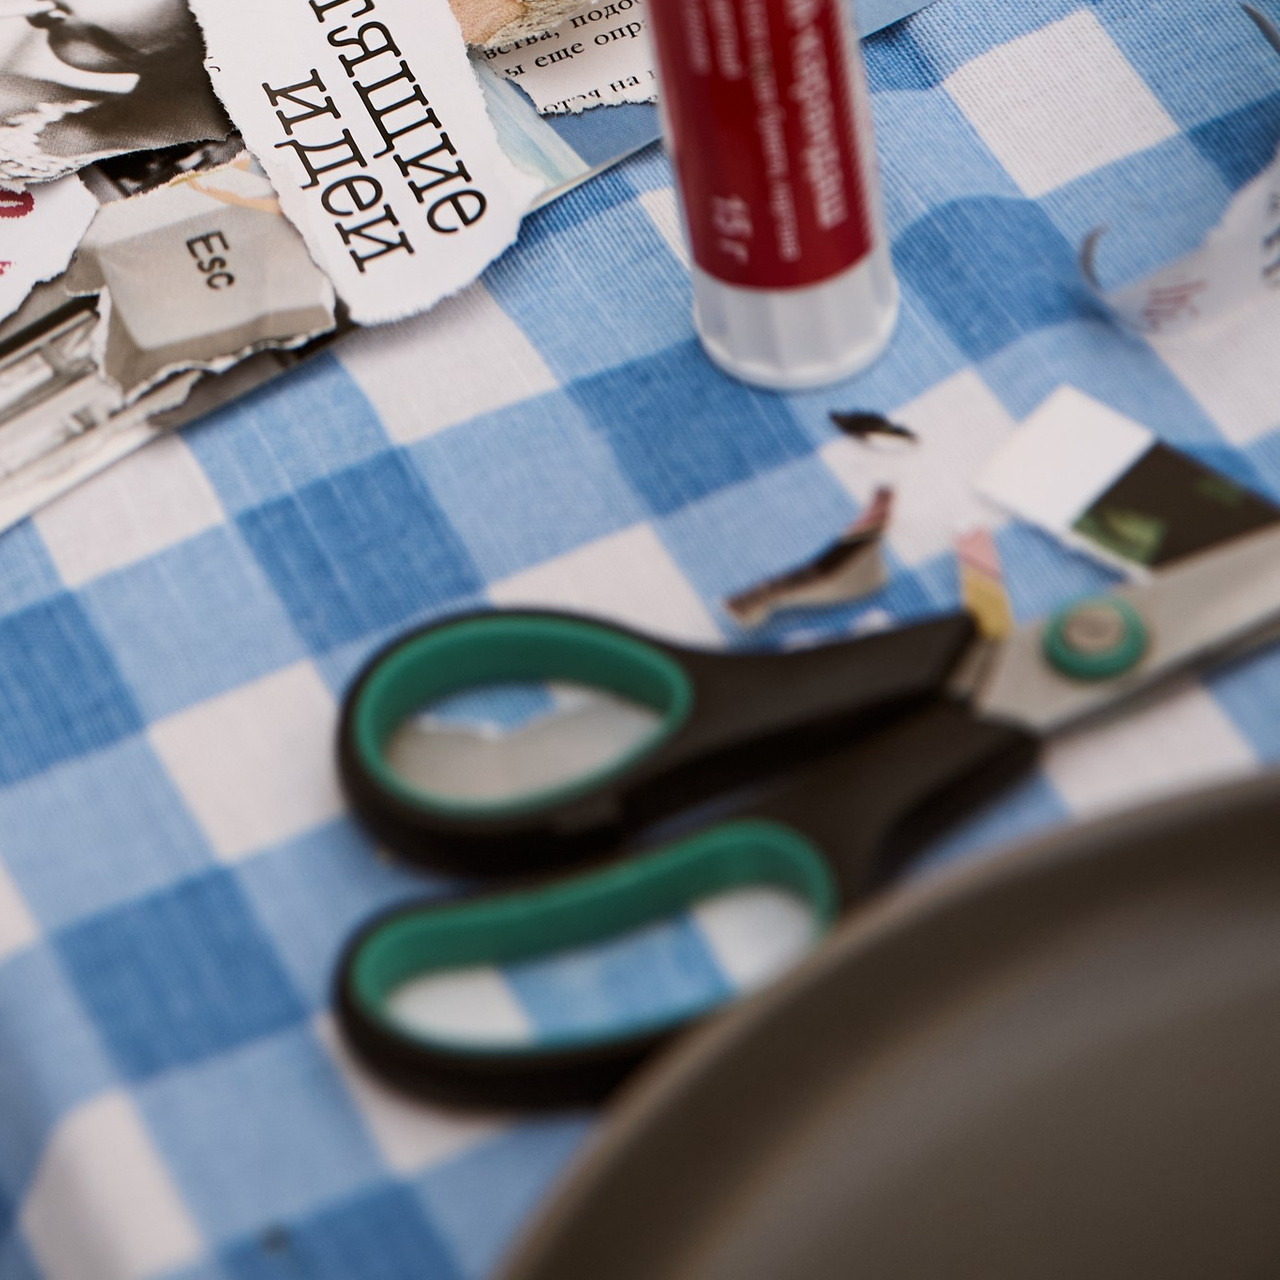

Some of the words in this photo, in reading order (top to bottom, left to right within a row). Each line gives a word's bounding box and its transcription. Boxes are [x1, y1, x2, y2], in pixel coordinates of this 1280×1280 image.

[535, 42, 585, 68] еще
[594, 19, 648, 46] опр
[610, 74, 640, 93] на
[261, 68, 415, 274] идеи
[186, 230, 236, 290] Esc
